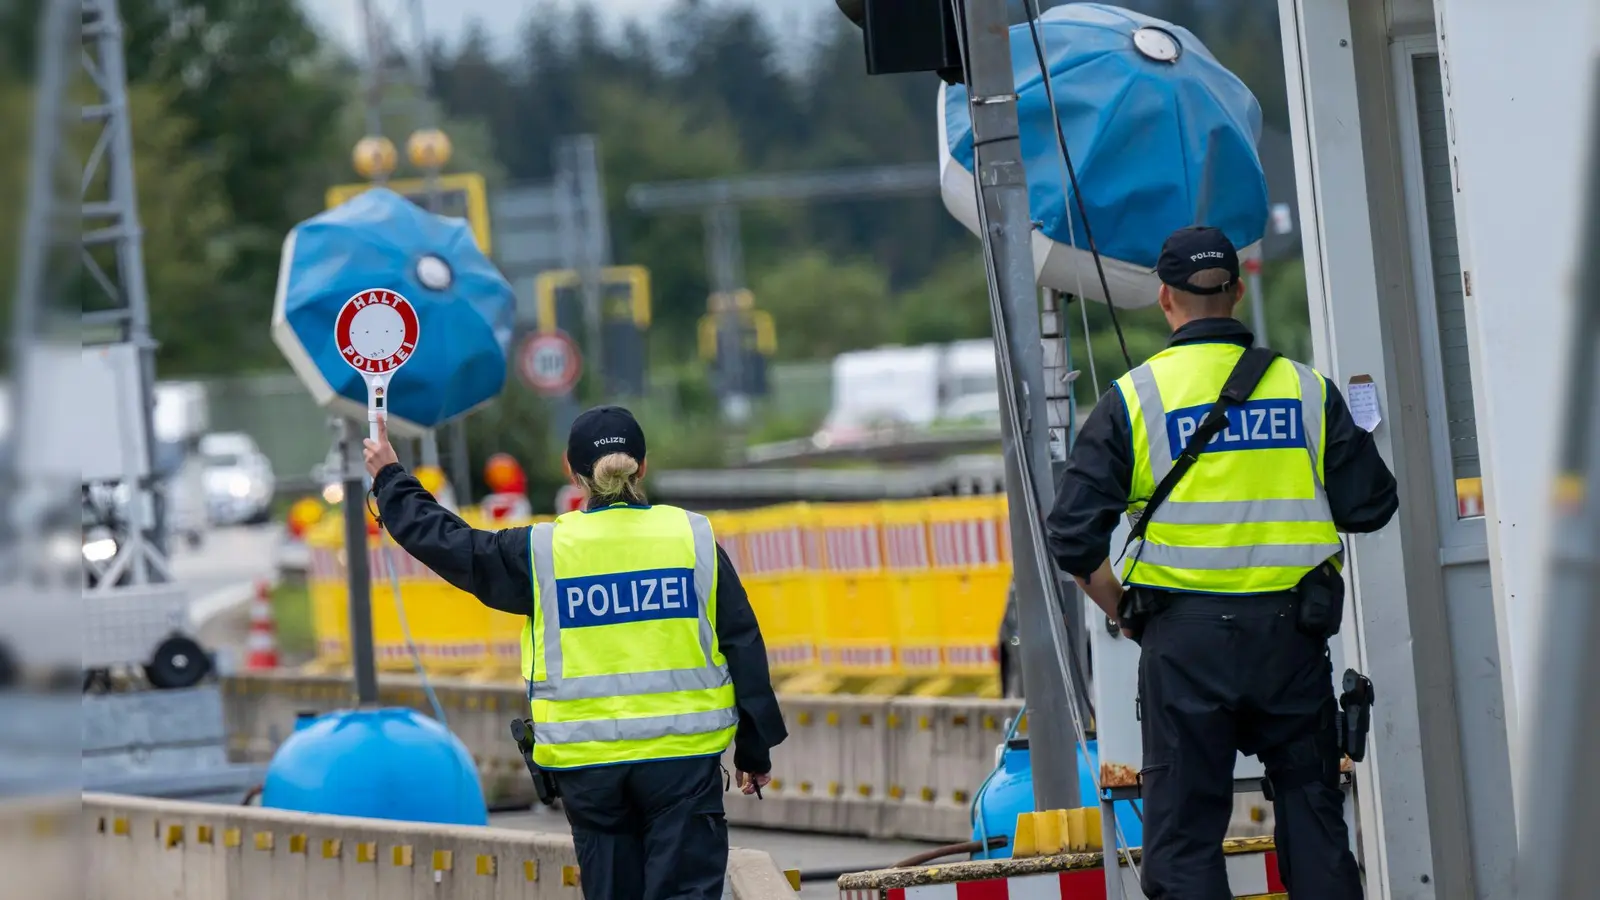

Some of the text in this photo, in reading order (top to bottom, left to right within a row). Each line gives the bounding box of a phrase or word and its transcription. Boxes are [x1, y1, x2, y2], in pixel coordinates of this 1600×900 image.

[1190, 251, 1224, 262] POLIZEI
[352, 292, 403, 310] HALT
[342, 341, 414, 372] POLIZEI
[593, 436, 626, 448] POLIZEI
[566, 576, 688, 619] POLIZEI
